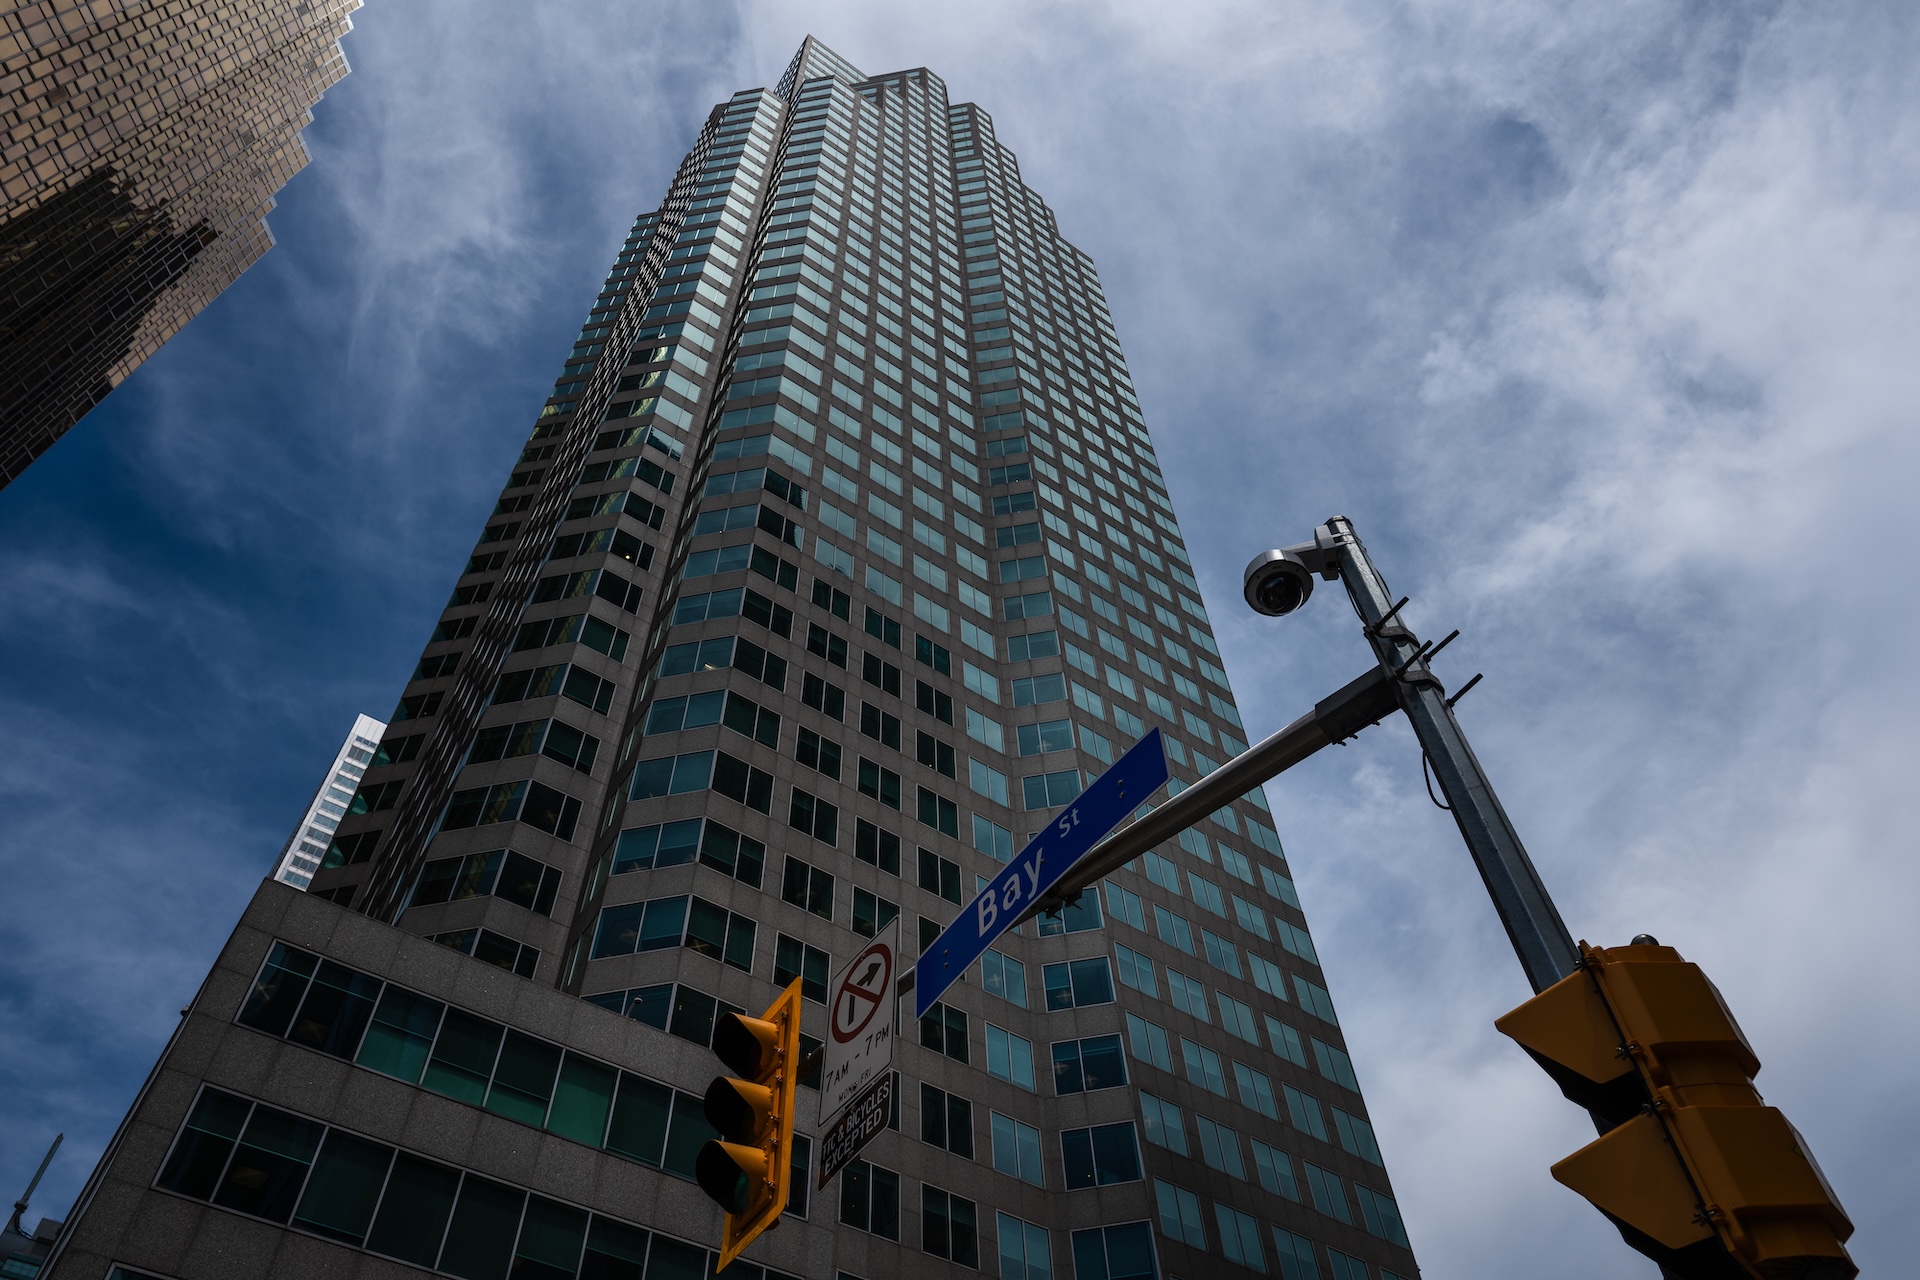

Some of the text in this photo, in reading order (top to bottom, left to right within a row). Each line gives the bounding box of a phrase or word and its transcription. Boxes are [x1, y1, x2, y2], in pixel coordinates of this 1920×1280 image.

[977, 808, 1079, 938] Bay St
[860, 1067, 871, 1083] FRI
[823, 1081, 889, 1159] TTC & BICYCLES
[825, 1108, 883, 1176] EXCEPTED
